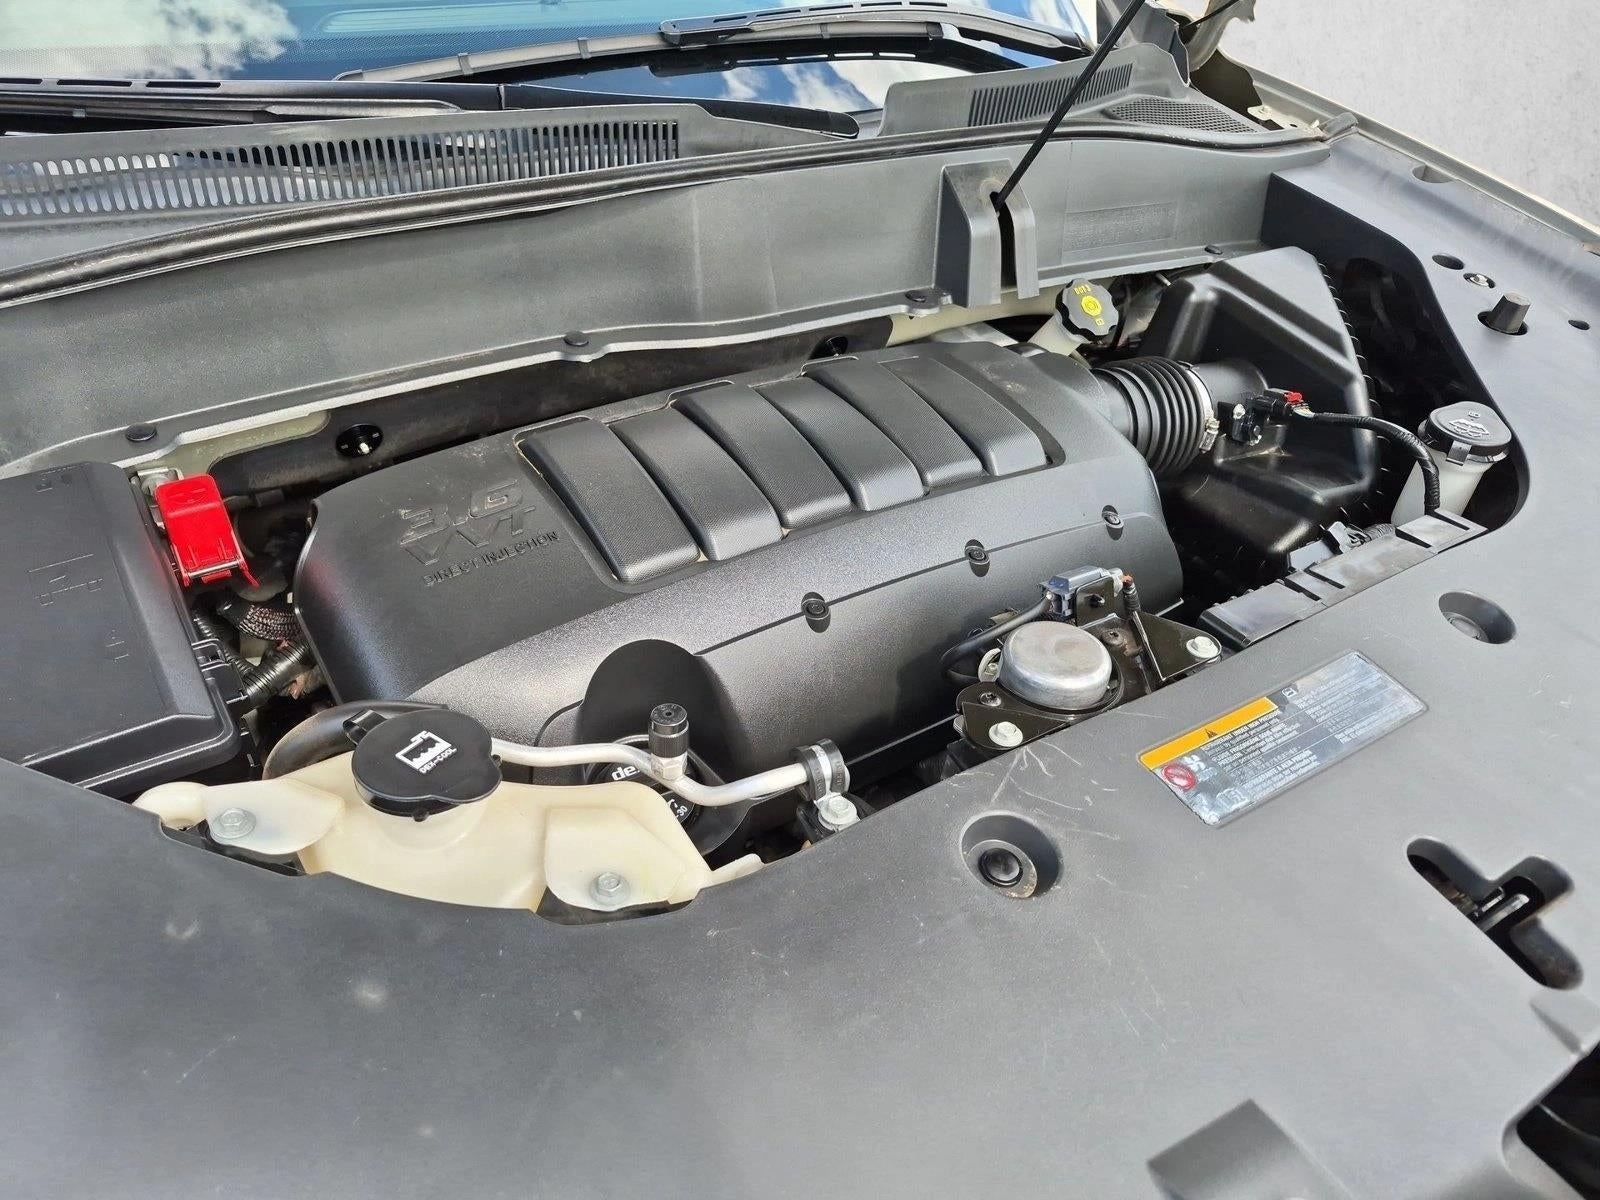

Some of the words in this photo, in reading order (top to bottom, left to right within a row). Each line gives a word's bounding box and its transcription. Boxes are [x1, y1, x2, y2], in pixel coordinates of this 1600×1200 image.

[400, 478, 523, 546] 3.6
[403, 504, 536, 567] VVT
[423, 557, 479, 587] DIRECT
[481, 530, 560, 568] INJECTION
[419, 747, 458, 774] DEX-COOL
